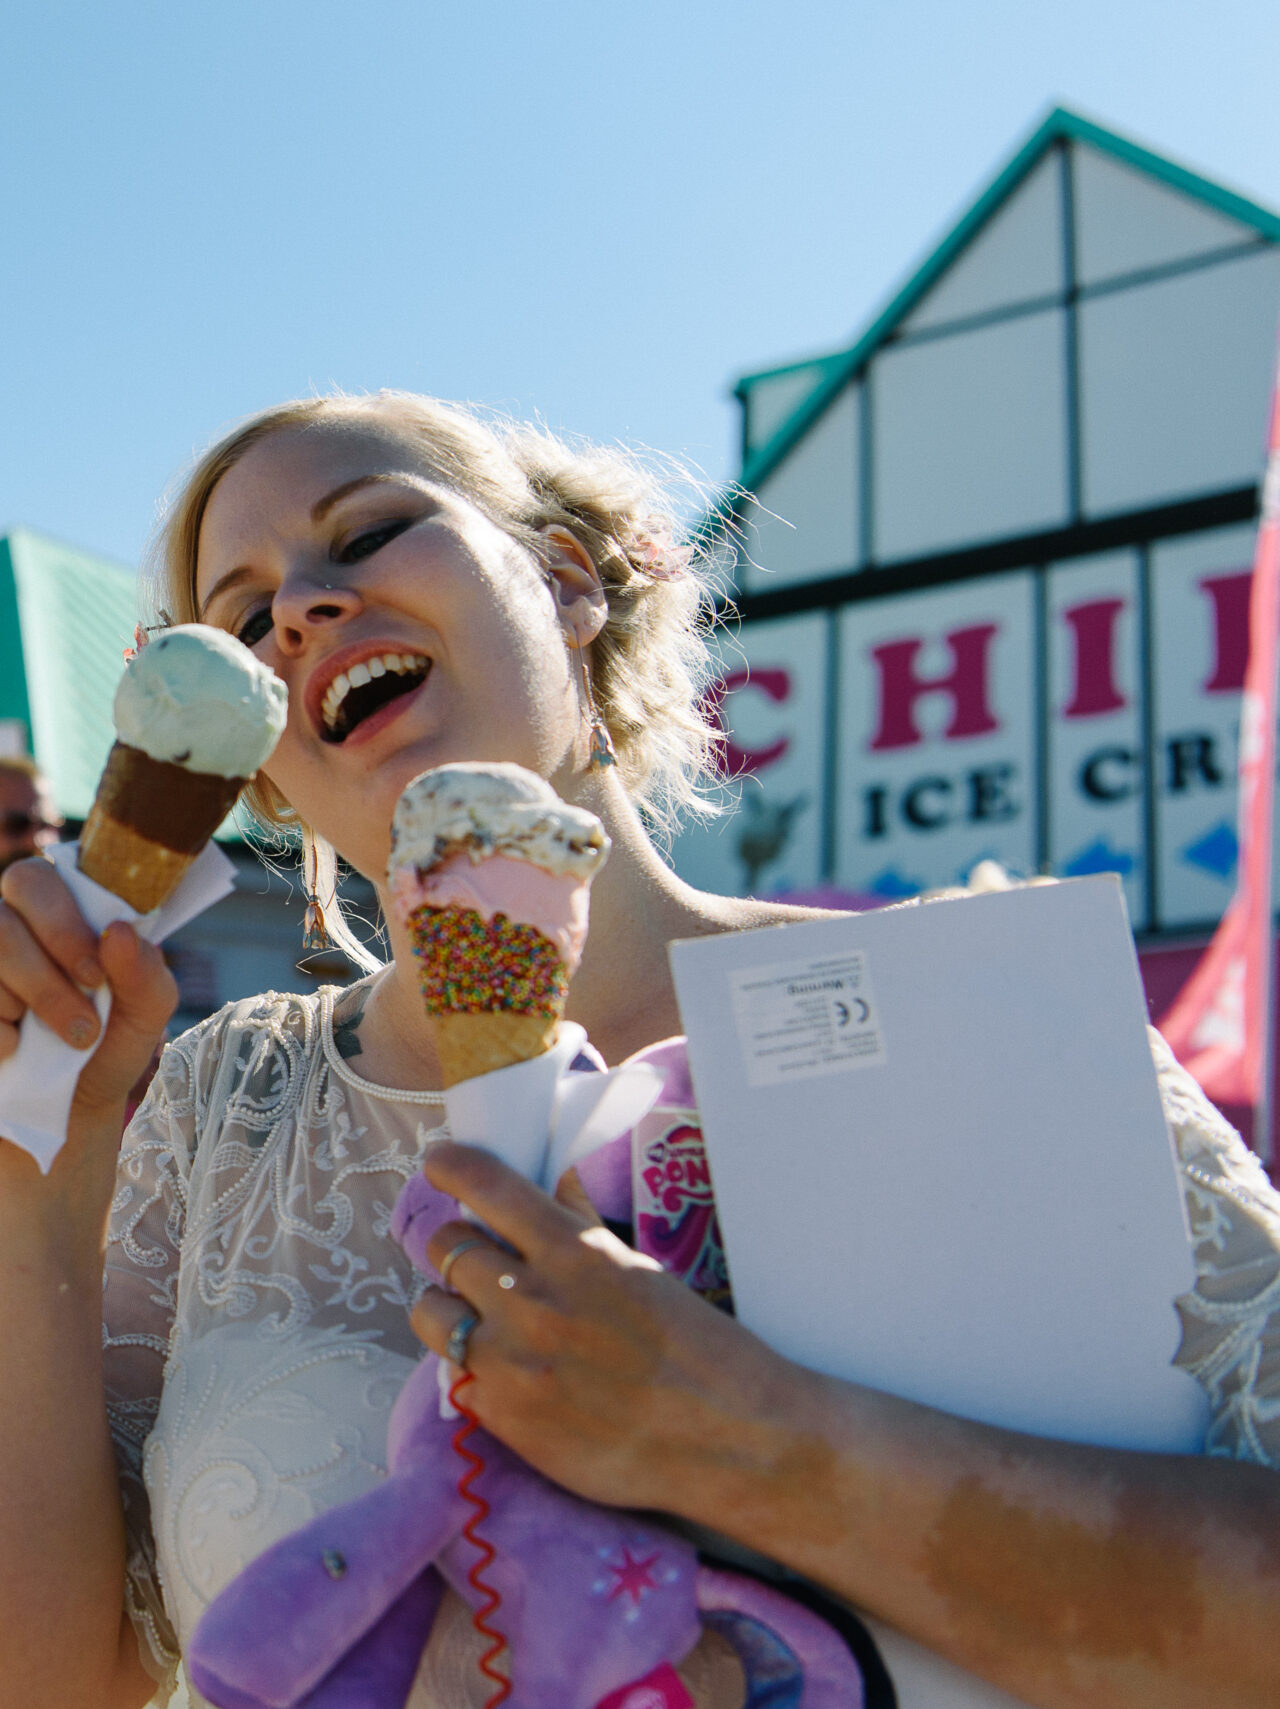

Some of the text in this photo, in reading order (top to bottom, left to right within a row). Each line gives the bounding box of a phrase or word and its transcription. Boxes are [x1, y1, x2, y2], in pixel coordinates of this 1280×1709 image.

[863, 714, 1239, 838] ICE CR
[642, 1158, 713, 1199] PON
